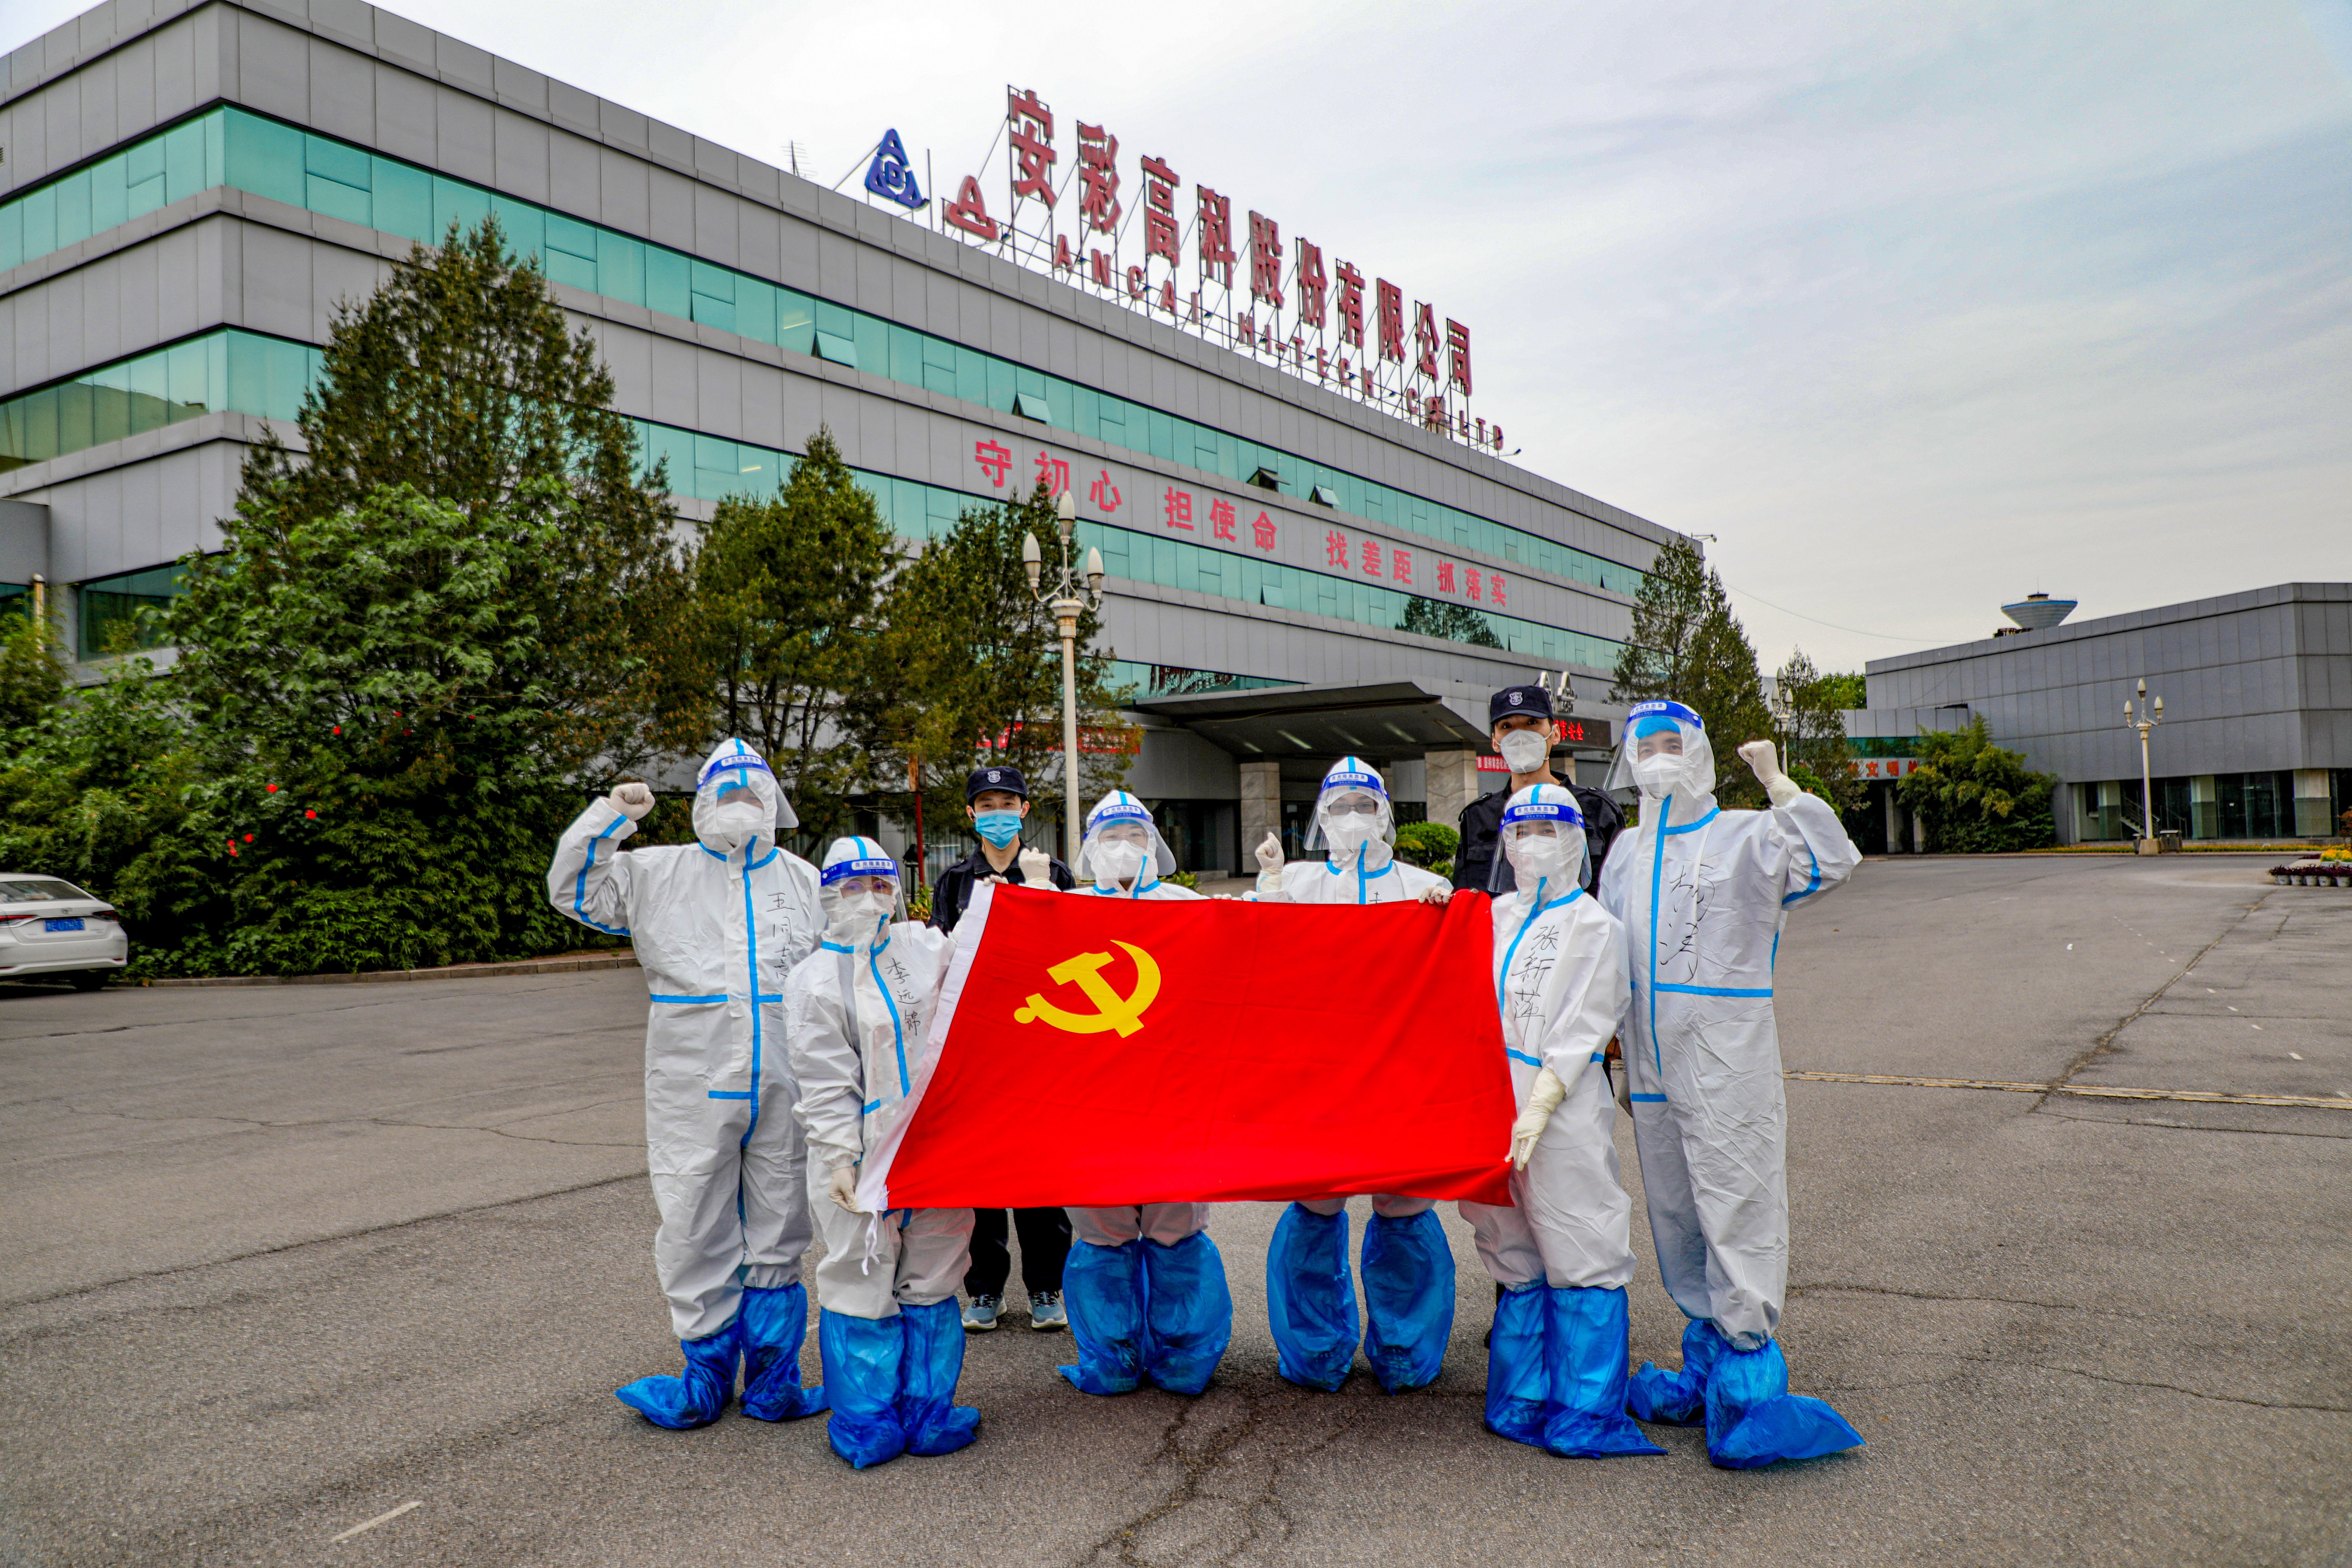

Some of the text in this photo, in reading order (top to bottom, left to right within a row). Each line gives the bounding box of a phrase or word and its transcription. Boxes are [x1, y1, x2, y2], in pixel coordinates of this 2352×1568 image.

[1010, 90, 1473, 397] 安彩高科股份有限公司
[1053, 234, 1199, 324] ANCAI
[1238, 312, 1374, 398] HI-TECH
[975, 439, 1507, 607] 守初心 担使命 找差距 抓落实
